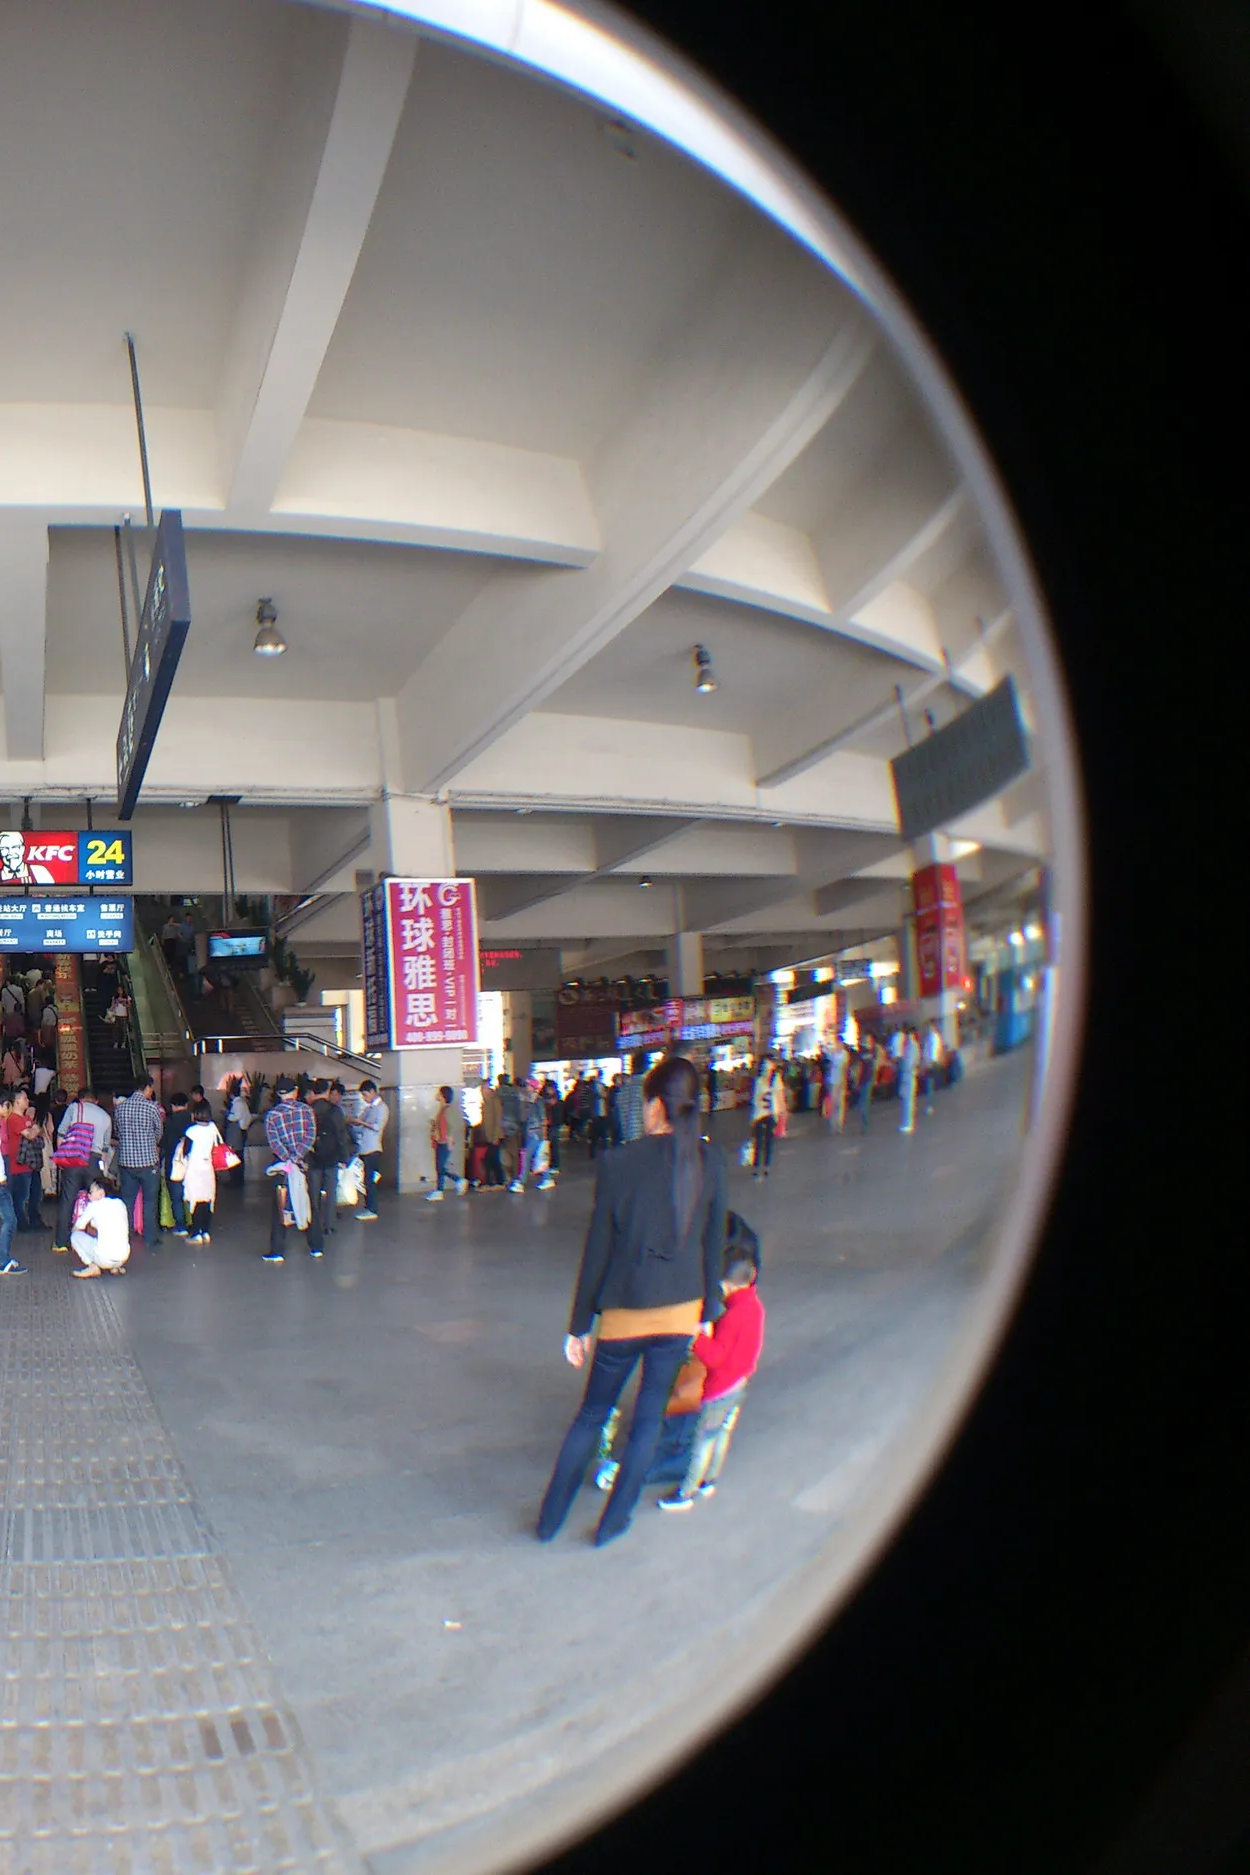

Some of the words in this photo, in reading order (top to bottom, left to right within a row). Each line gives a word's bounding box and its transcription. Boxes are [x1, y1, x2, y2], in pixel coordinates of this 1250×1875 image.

[27, 845, 75, 862] KFC
[86, 840, 125, 865] 24
[85, 870, 125, 880] 小时营业
[398, 882, 438, 1027] 环球雅思
